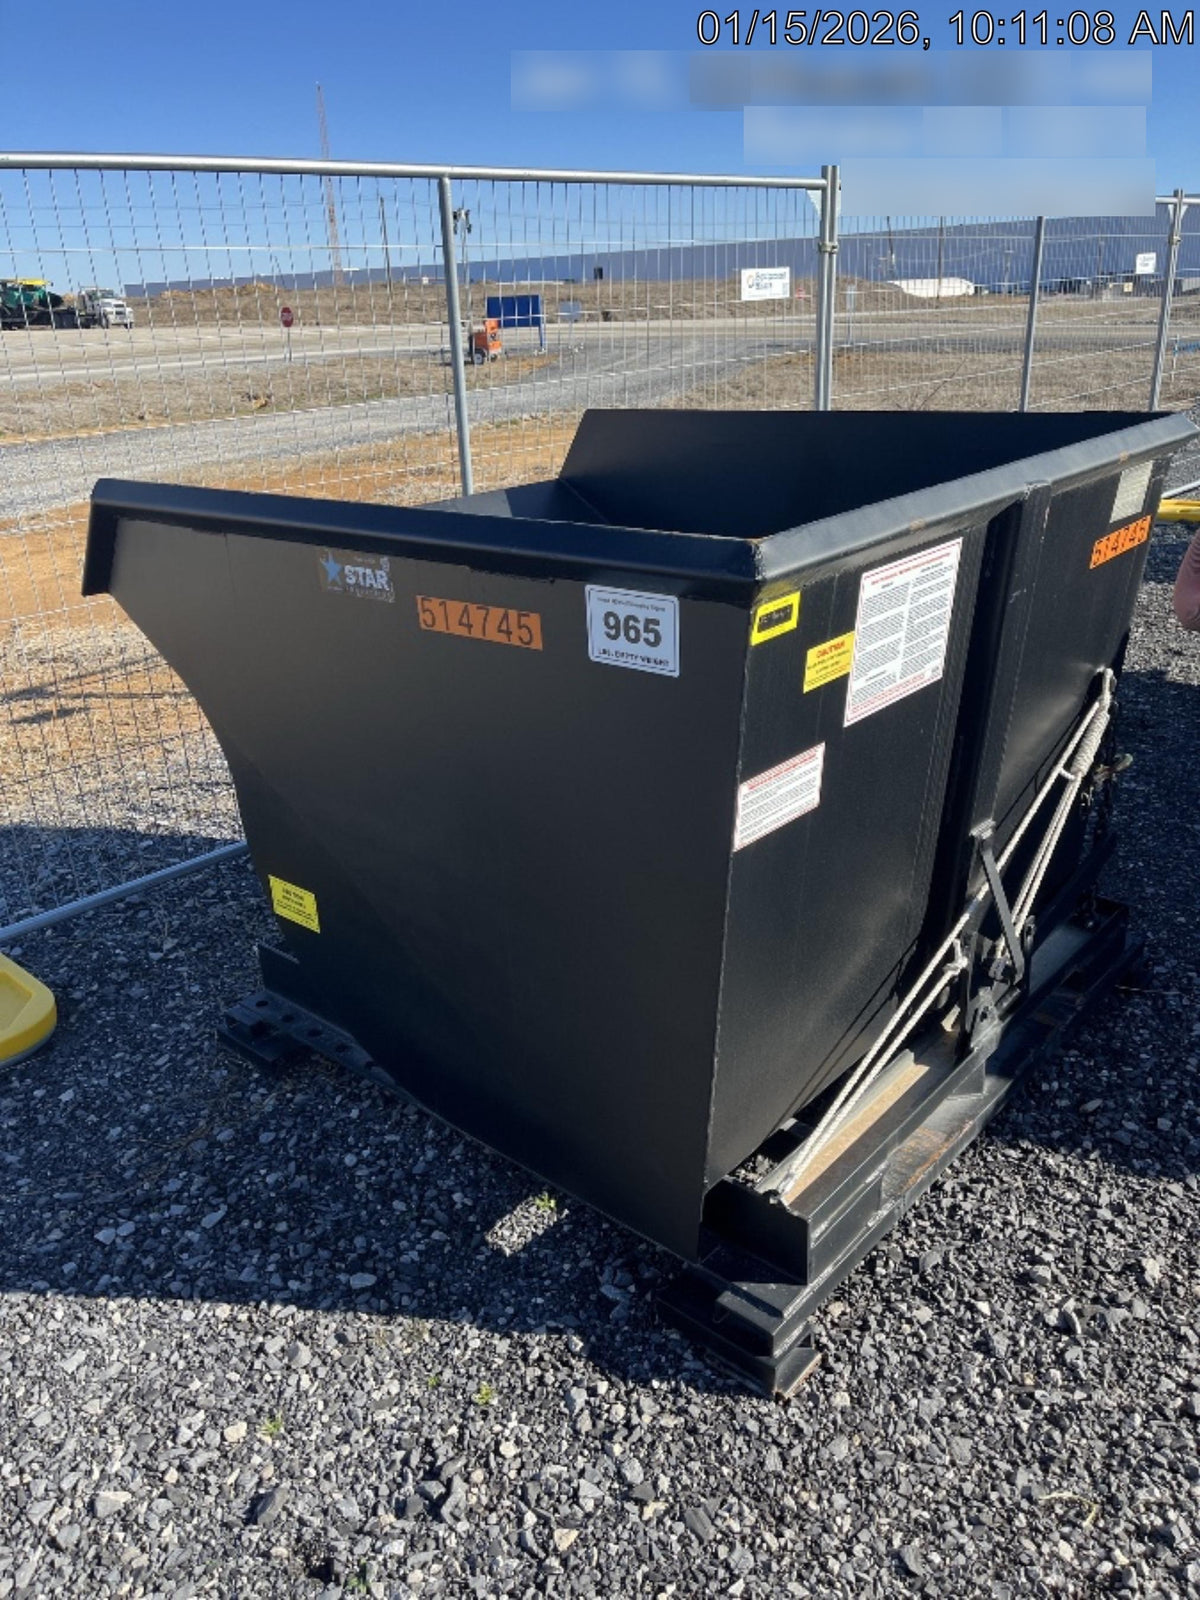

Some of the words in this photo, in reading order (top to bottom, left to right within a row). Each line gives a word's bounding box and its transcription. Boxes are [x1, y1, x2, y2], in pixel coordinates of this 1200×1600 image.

[344, 565, 390, 591] STAR
[421, 596, 533, 646] 514745
[603, 611, 662, 648] 965
